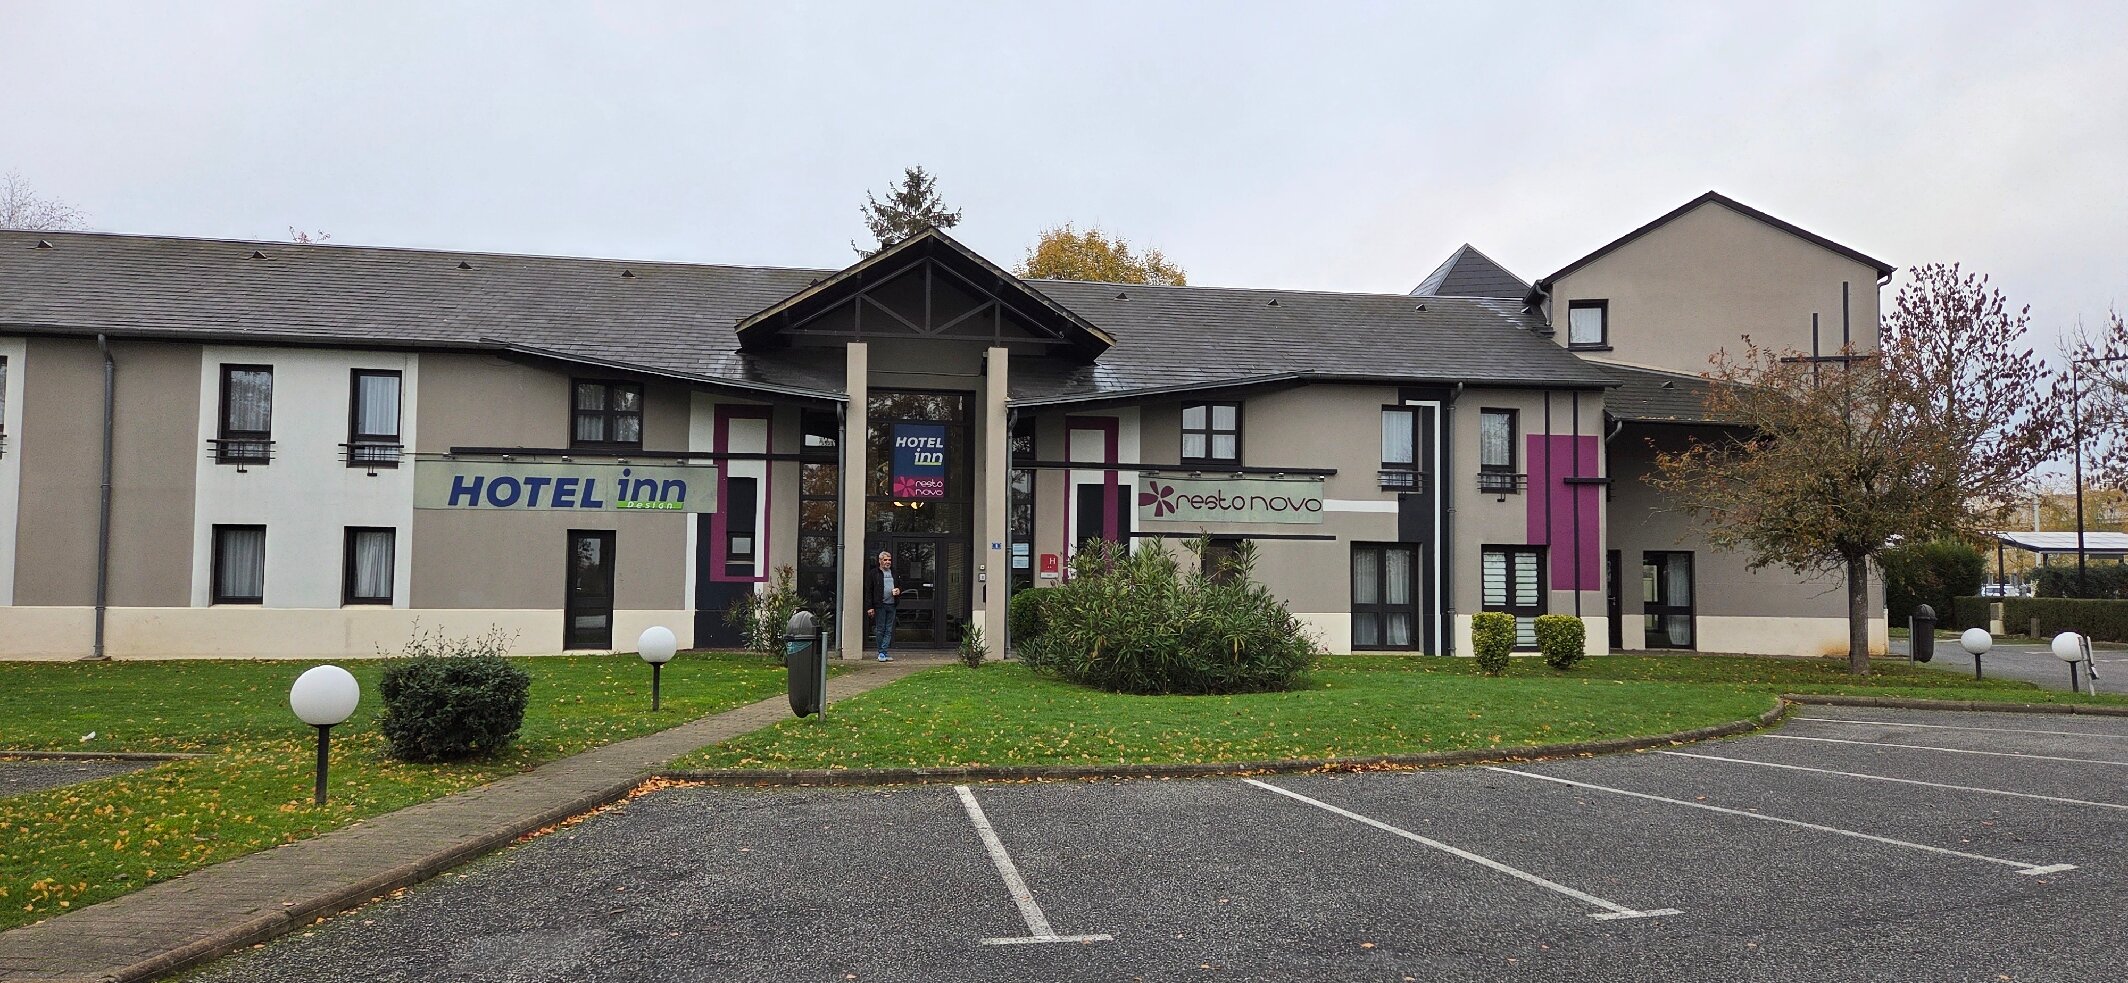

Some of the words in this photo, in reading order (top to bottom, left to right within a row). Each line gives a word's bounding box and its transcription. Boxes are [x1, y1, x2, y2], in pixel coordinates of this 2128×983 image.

[895, 436, 944, 448] HOTEL
[914, 447, 943, 463] inn
[447, 475, 604, 509] HOTEL
[616, 468, 687, 502] inn
[915, 478, 943, 488] resto
[915, 488, 943, 496] novo
[626, 501, 673, 510] Design
[1176, 489, 1246, 511] resto
[1250, 495, 1322, 512] novo
[1049, 557, 1056, 565] H
